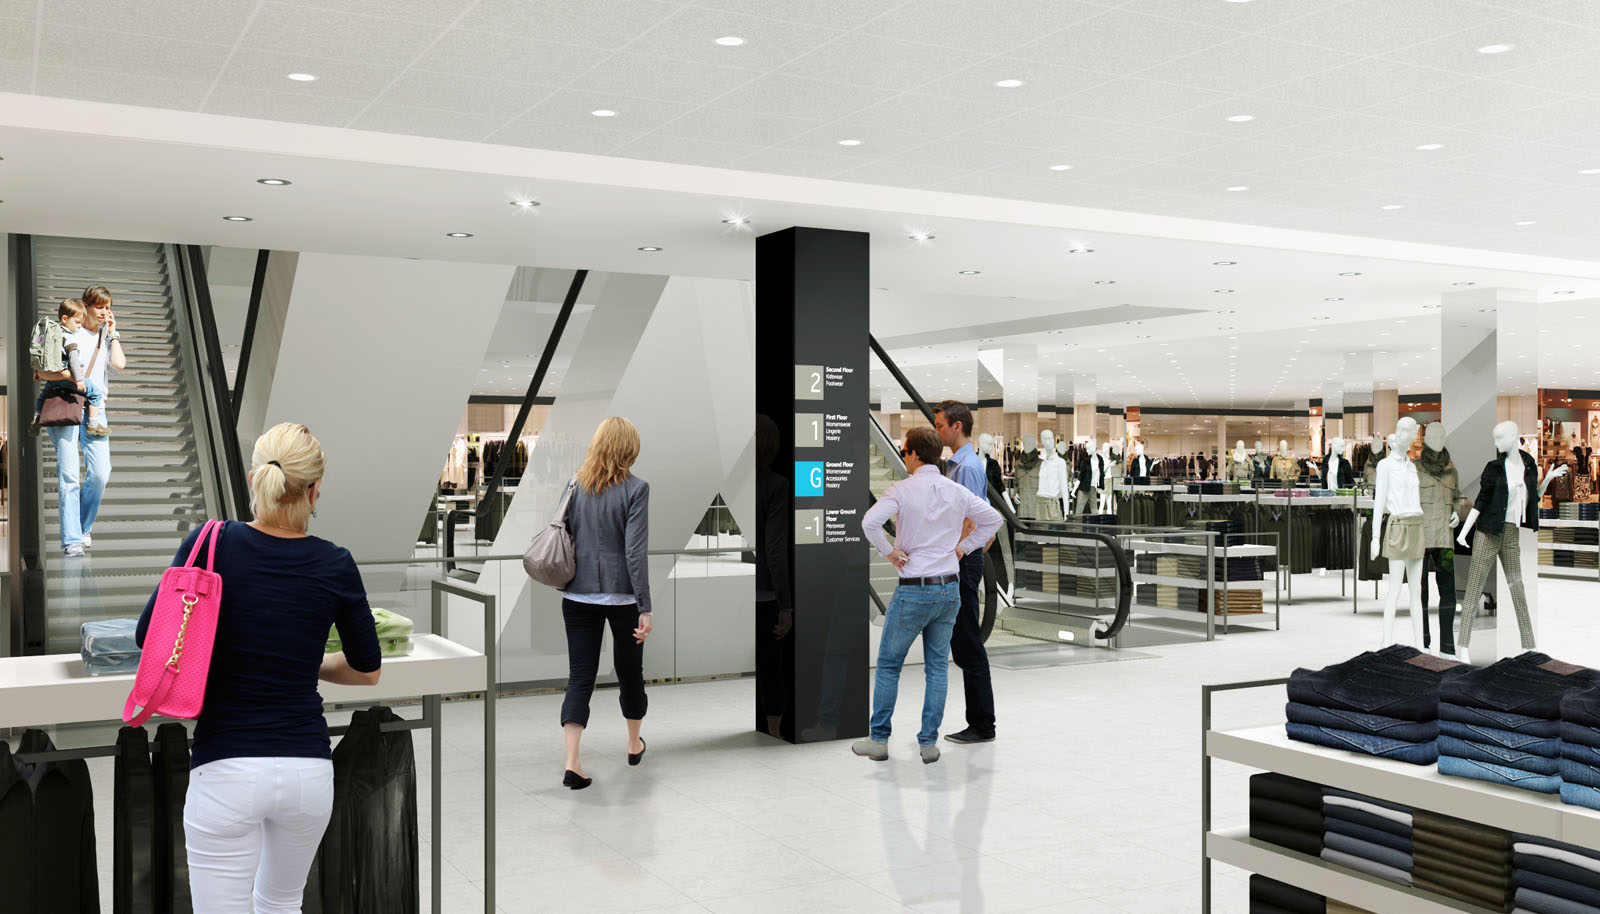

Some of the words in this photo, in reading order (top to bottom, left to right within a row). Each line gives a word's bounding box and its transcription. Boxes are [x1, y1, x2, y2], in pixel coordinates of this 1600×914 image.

[810, 372, 821, 392] 2
[811, 420, 818, 440] 1
[810, 467, 822, 488] G
[804, 516, 820, 536] -1
